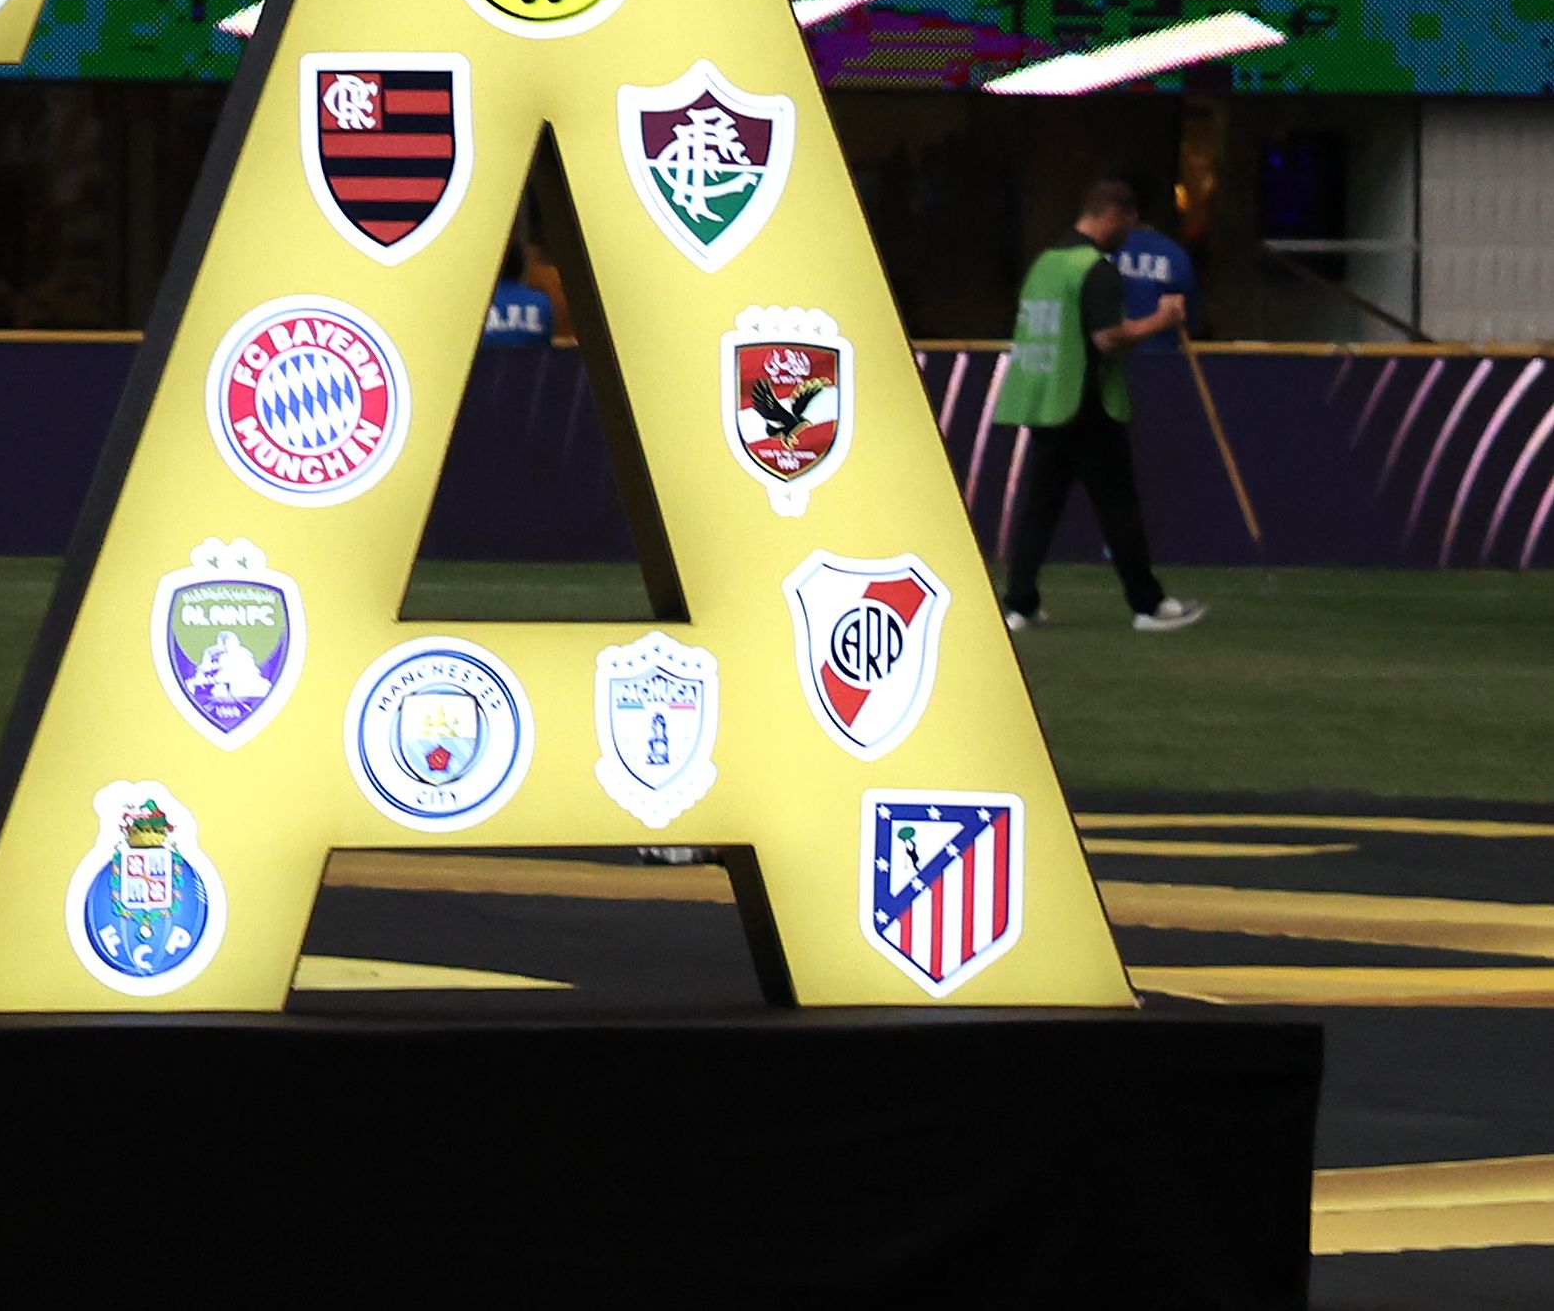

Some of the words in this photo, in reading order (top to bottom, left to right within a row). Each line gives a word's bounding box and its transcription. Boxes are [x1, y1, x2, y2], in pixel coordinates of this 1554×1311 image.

[234, 343, 271, 387] FC
[267, 319, 384, 391] BAYERN
[830, 605, 904, 682] CARP
[416, 791, 462, 807] CITY
